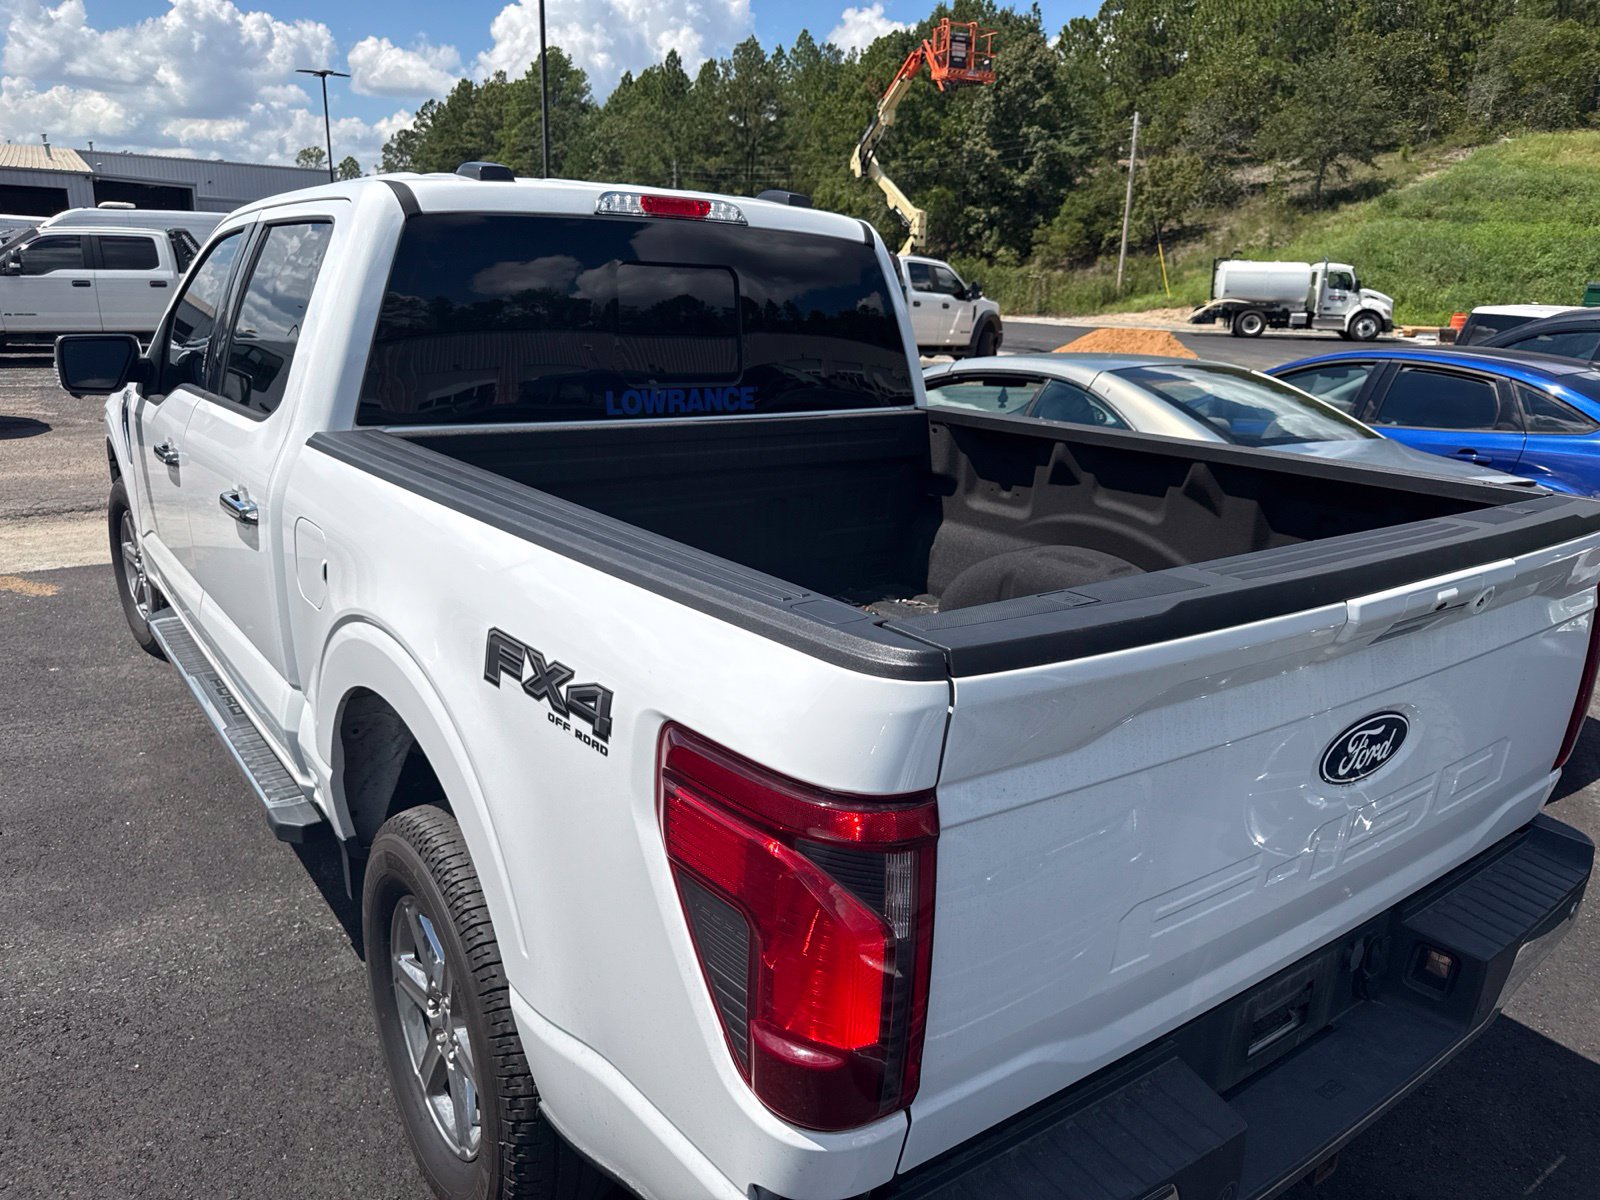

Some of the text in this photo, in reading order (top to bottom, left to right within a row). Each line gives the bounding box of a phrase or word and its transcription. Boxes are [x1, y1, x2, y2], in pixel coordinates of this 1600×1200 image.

[605, 386, 756, 416] LOWRANCE
[483, 626, 614, 745] FX4
[547, 711, 609, 757] OFF ROAD
[1338, 724, 1397, 776] Ford
